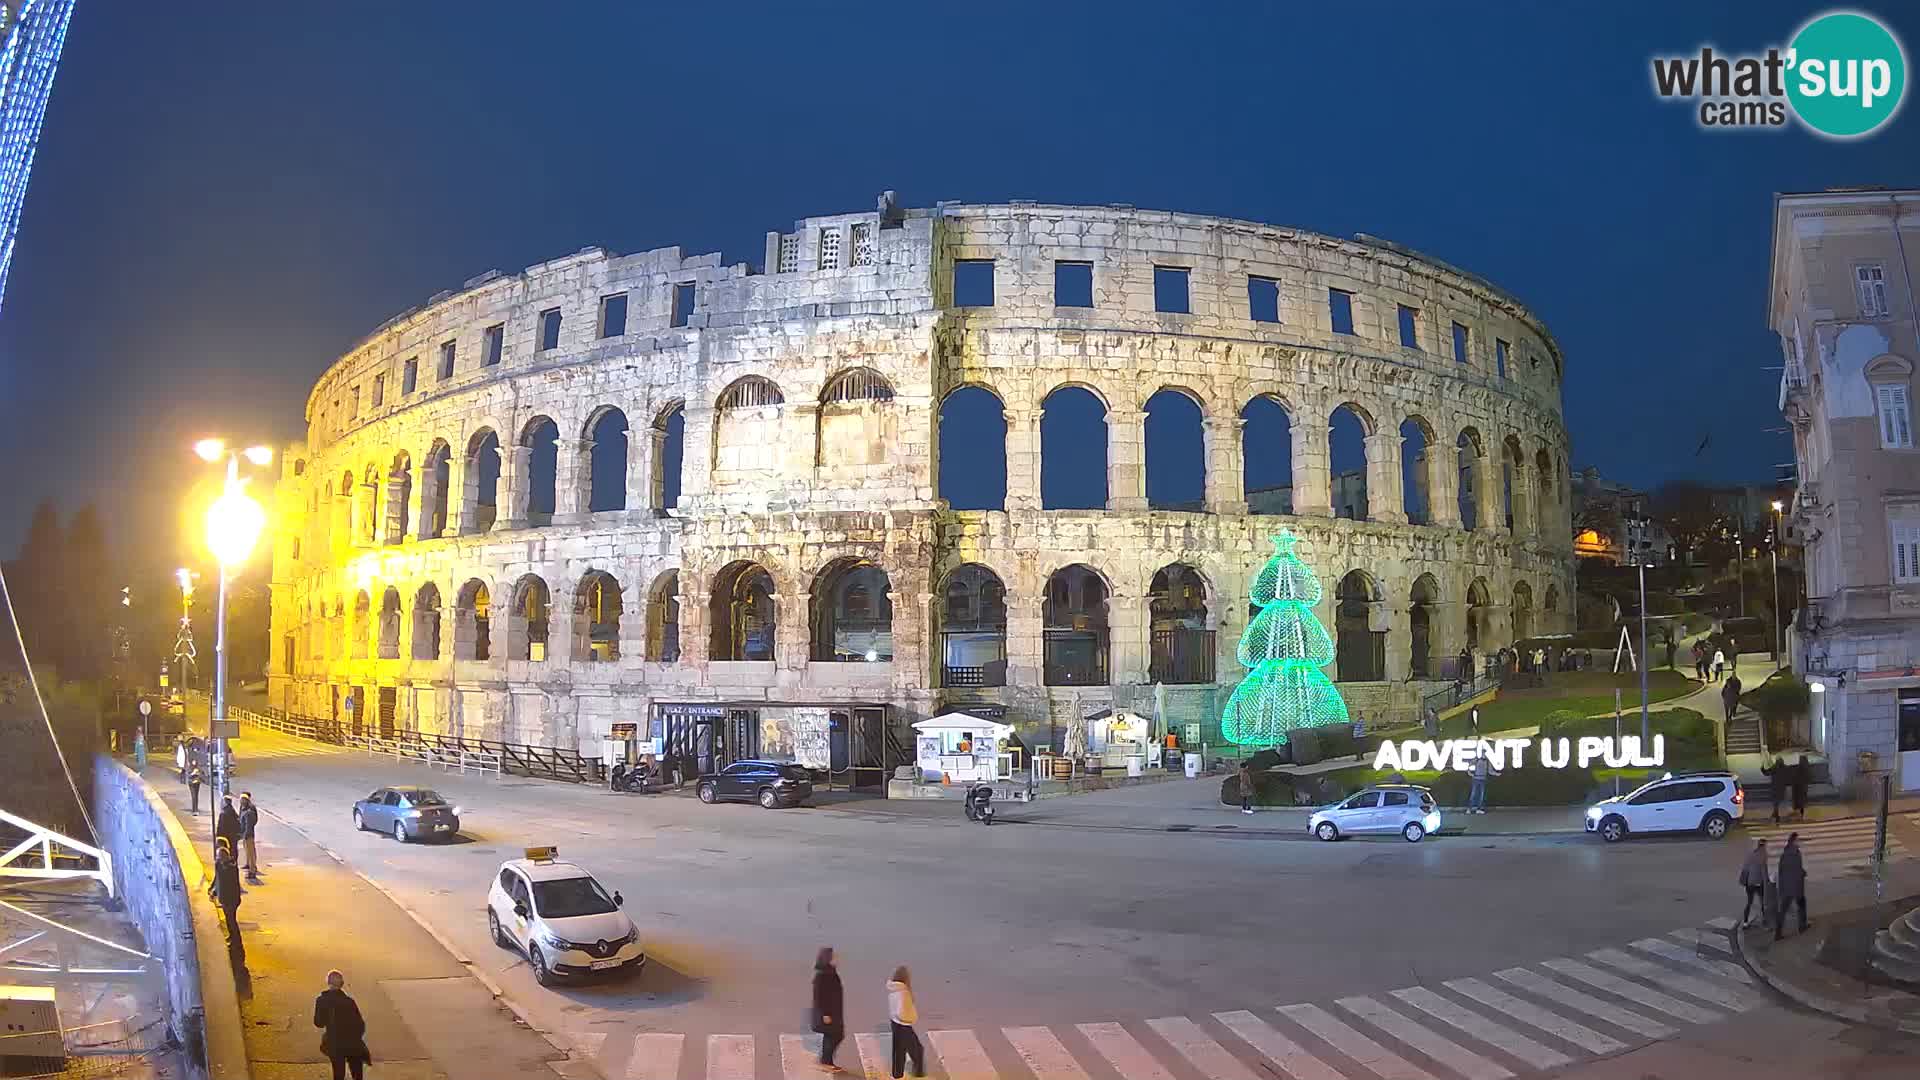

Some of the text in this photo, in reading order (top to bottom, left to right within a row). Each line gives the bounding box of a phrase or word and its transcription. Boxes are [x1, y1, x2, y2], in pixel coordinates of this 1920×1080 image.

[689, 707, 723, 715] ENTRANCE
[1373, 734, 1665, 771] ADVENT U PULI
